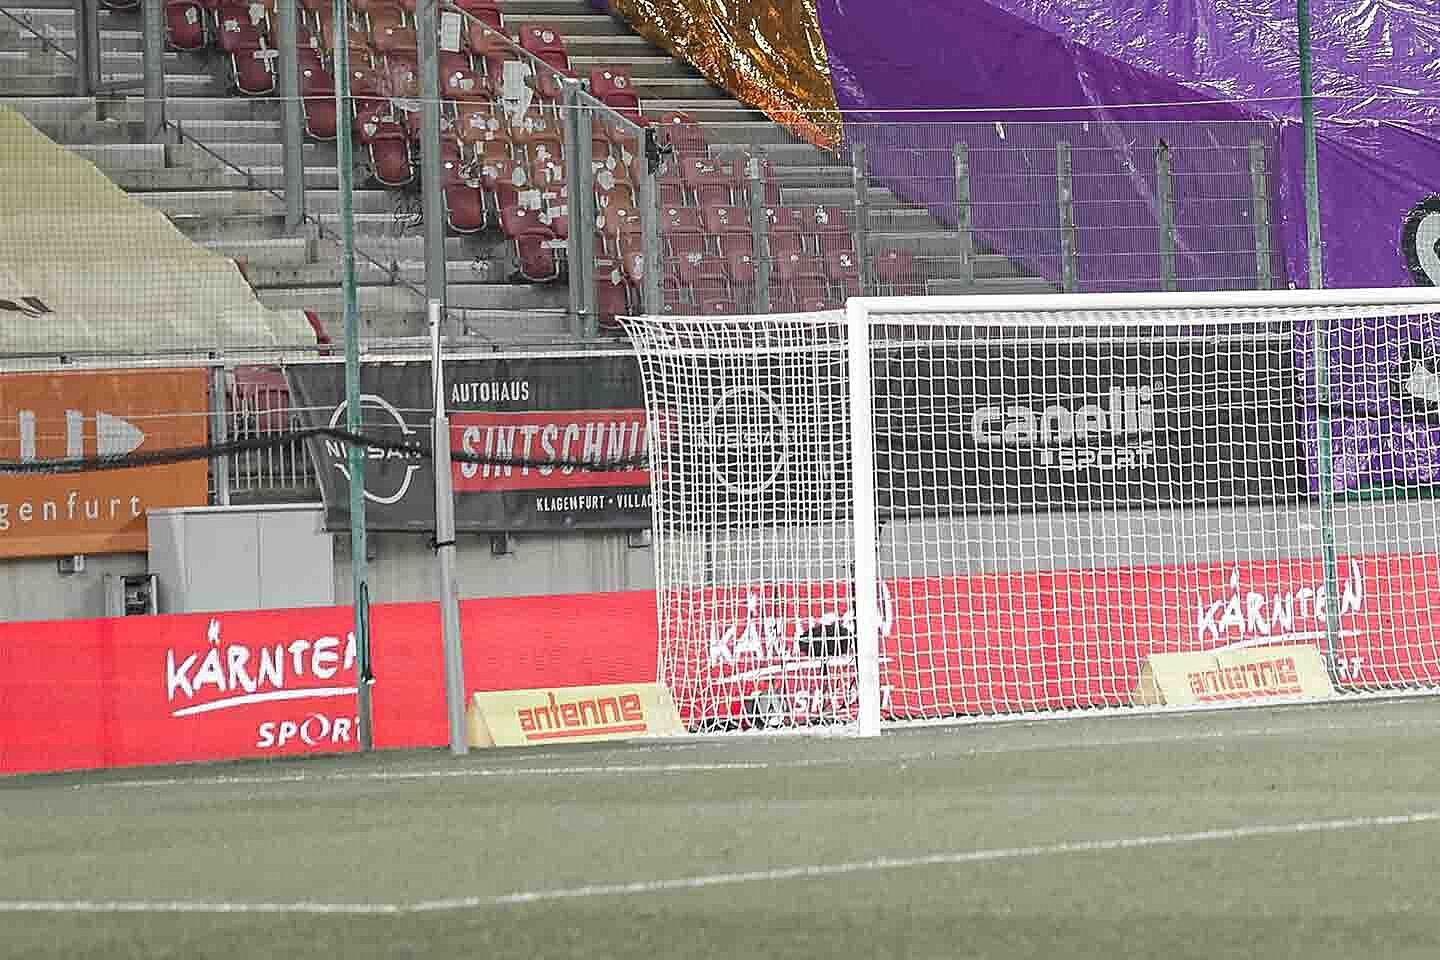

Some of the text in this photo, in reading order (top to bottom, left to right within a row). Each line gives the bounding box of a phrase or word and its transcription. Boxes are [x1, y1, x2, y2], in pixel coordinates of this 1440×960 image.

[451, 381, 529, 402] AUTOHAUS
[536, 492, 654, 512] KLAGENFURT VILLAC
[518, 692, 642, 732] antenne
